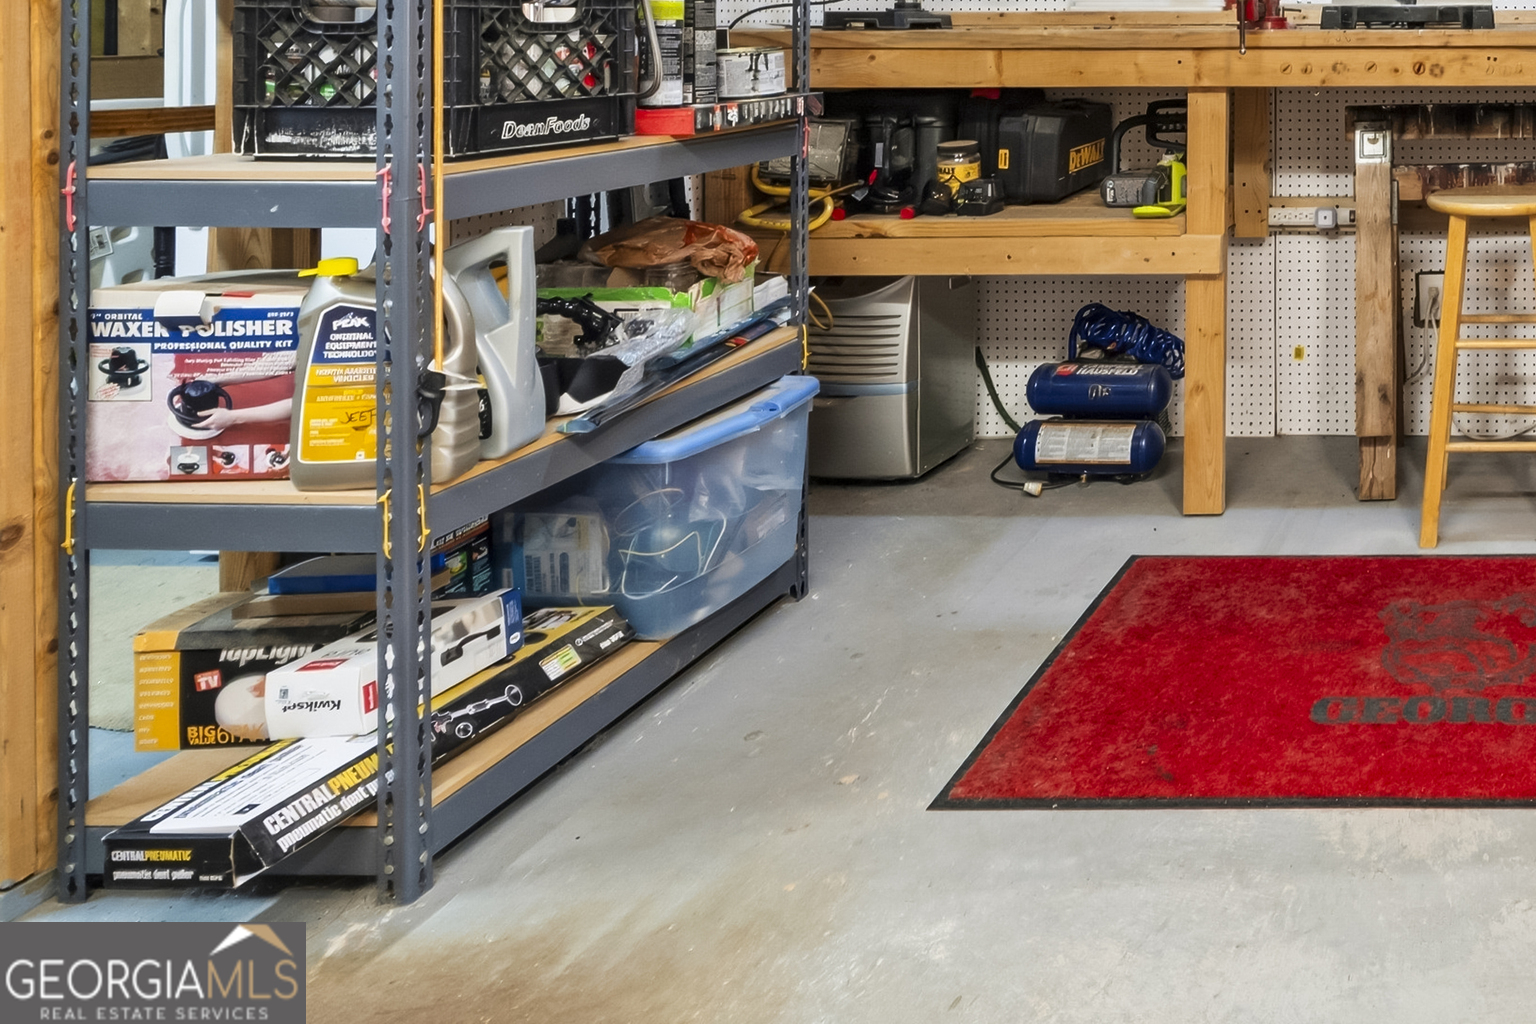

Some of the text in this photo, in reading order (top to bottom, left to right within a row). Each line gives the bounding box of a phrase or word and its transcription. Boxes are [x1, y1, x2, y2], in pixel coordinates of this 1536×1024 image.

[104, 312, 143, 320] ORBITAL
[177, 319, 293, 338] POLISHER
[153, 339, 293, 351] PROFESSIONAL QUALITY KIT
[199, 675, 219, 690] TV
[187, 726, 216, 738] BIG
